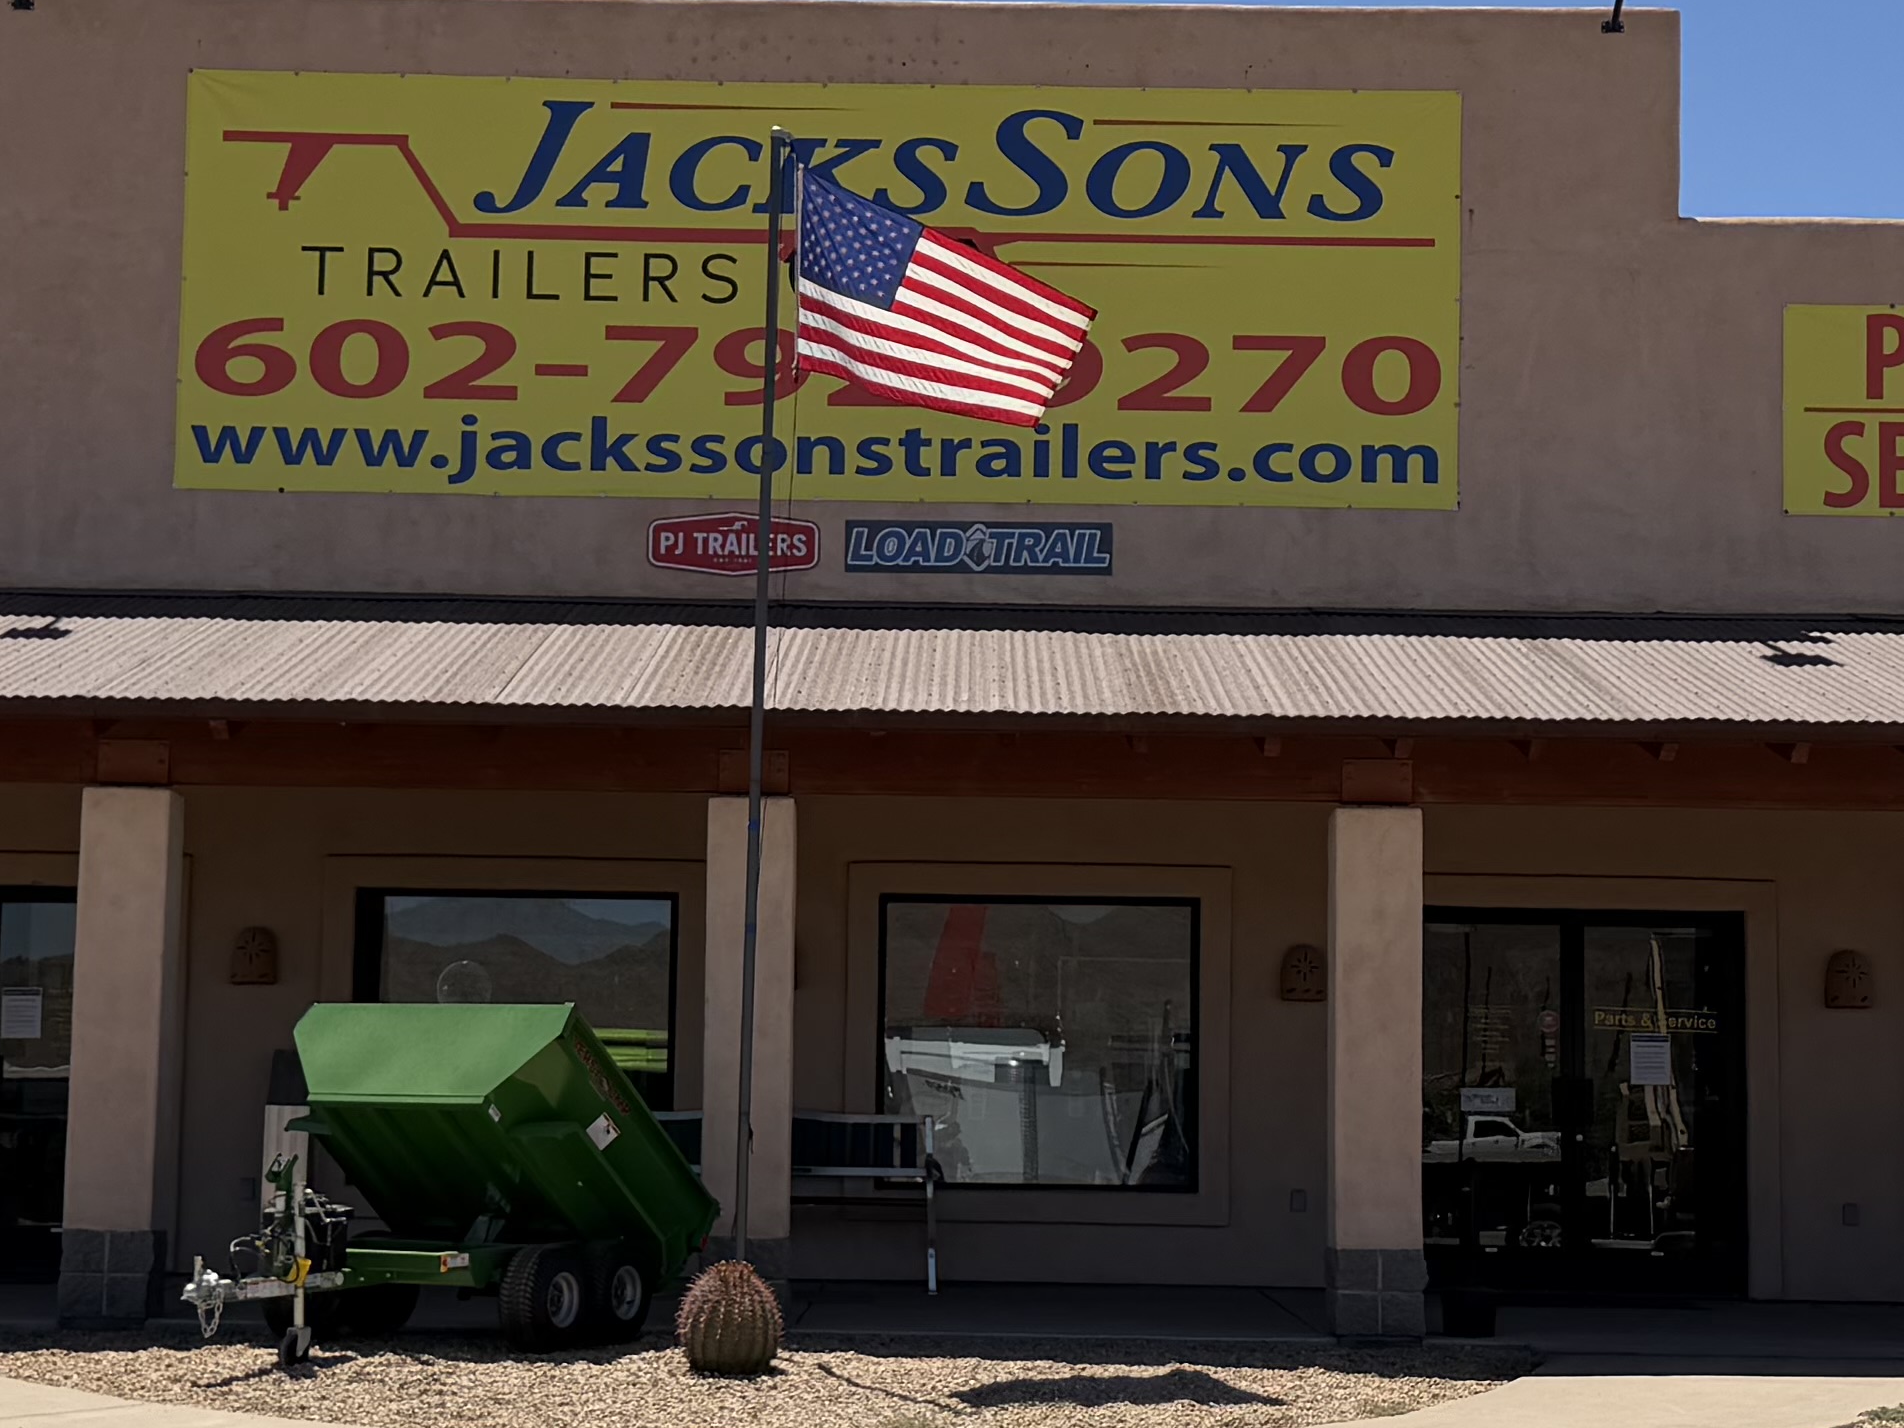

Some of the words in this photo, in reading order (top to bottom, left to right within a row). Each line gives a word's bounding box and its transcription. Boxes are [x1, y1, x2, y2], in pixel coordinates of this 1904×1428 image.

[301, 244, 739, 304] TRAILERS
[194, 317, 1442, 415] 602-79270
[190, 414, 1439, 485] www.jackssonstrailers.com
[659, 531, 684, 555] PJ
[847, 526, 967, 566] LOAD
[986, 527, 1110, 566] TRAIL
[1594, 1010, 1636, 1026] Parts
[1640, 1012, 1653, 1027] &
[1658, 1014, 1716, 1029] ervice
